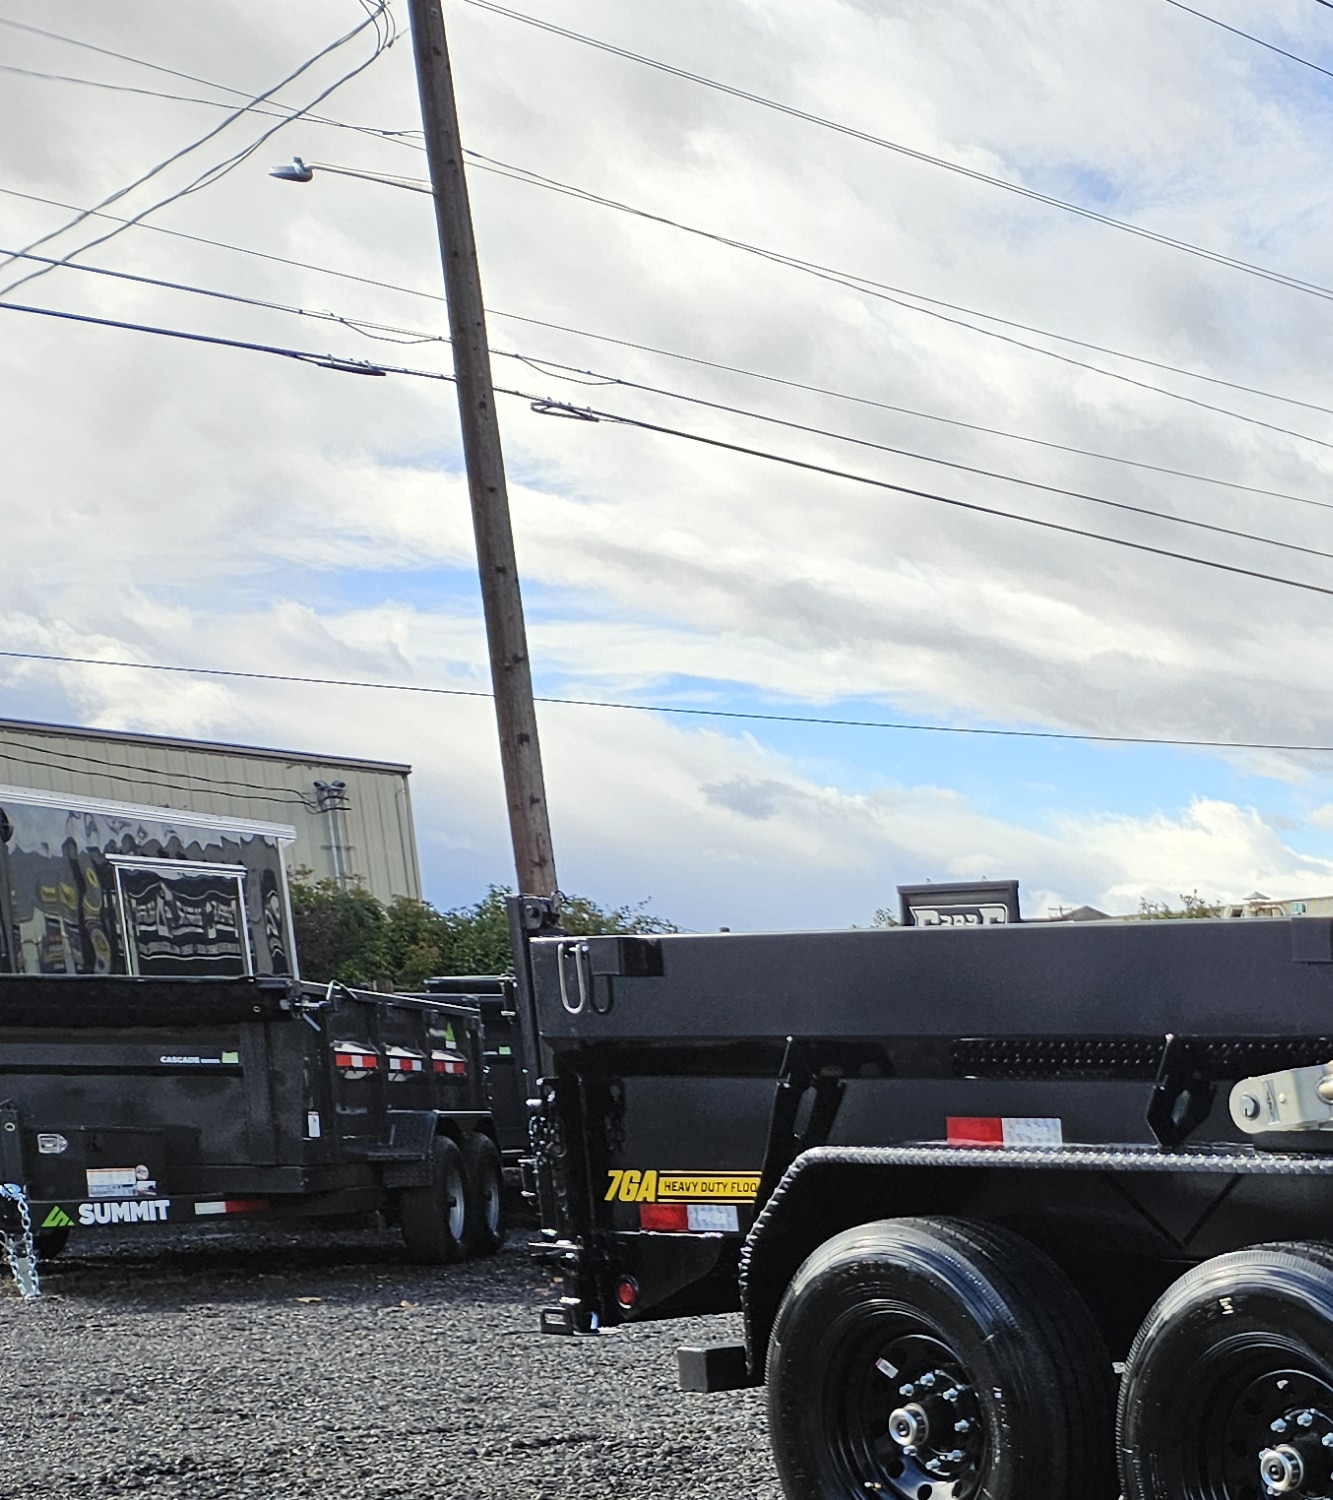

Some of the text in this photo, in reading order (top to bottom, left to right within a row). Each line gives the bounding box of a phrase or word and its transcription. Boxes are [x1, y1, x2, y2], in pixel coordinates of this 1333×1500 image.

[604, 1170, 658, 1202] 7GA
[664, 1181, 759, 1193] HEAVY DUTY FLOO
[78, 1200, 170, 1225] SUMMIT
